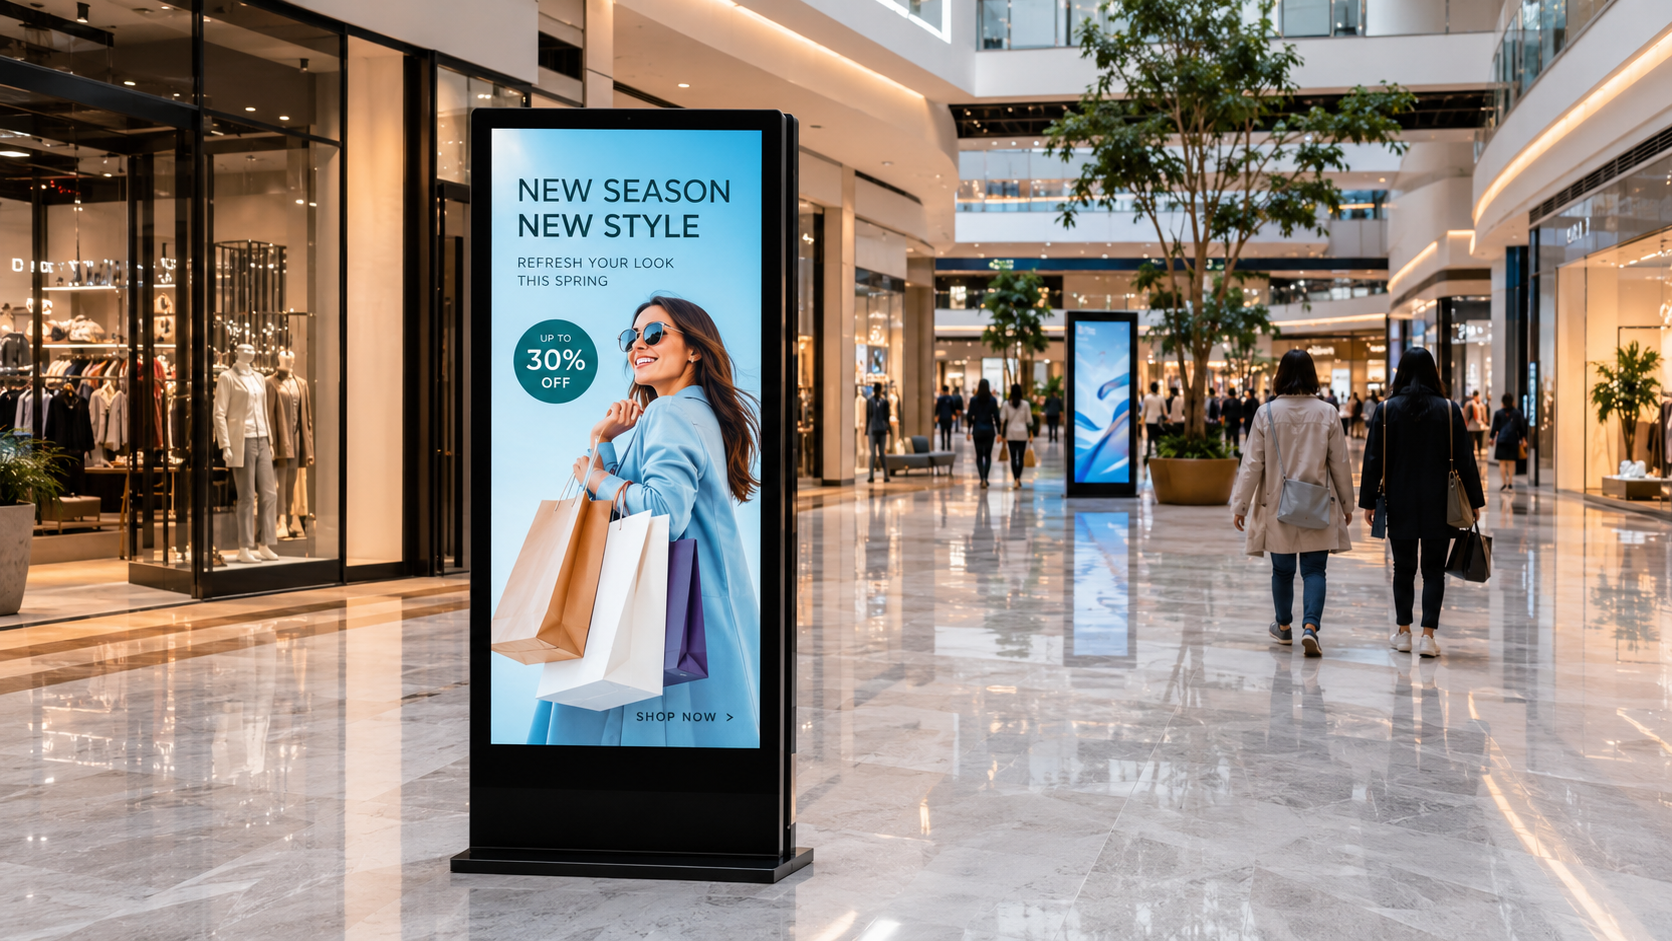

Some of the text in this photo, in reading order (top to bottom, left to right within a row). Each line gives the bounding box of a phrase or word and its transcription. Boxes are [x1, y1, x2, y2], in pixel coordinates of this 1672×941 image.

[518, 178, 730, 204] NEW SEASON
[518, 213, 700, 238] NEW STYLE
[517, 256, 675, 269] REFRESH YOUR LOOK
[517, 275, 608, 287] THIS SPRING
[540, 334, 572, 343] UP TO
[526, 348, 586, 371] 30%
[541, 376, 571, 389] OFF
[636, 711, 717, 722] SHOP NOW
